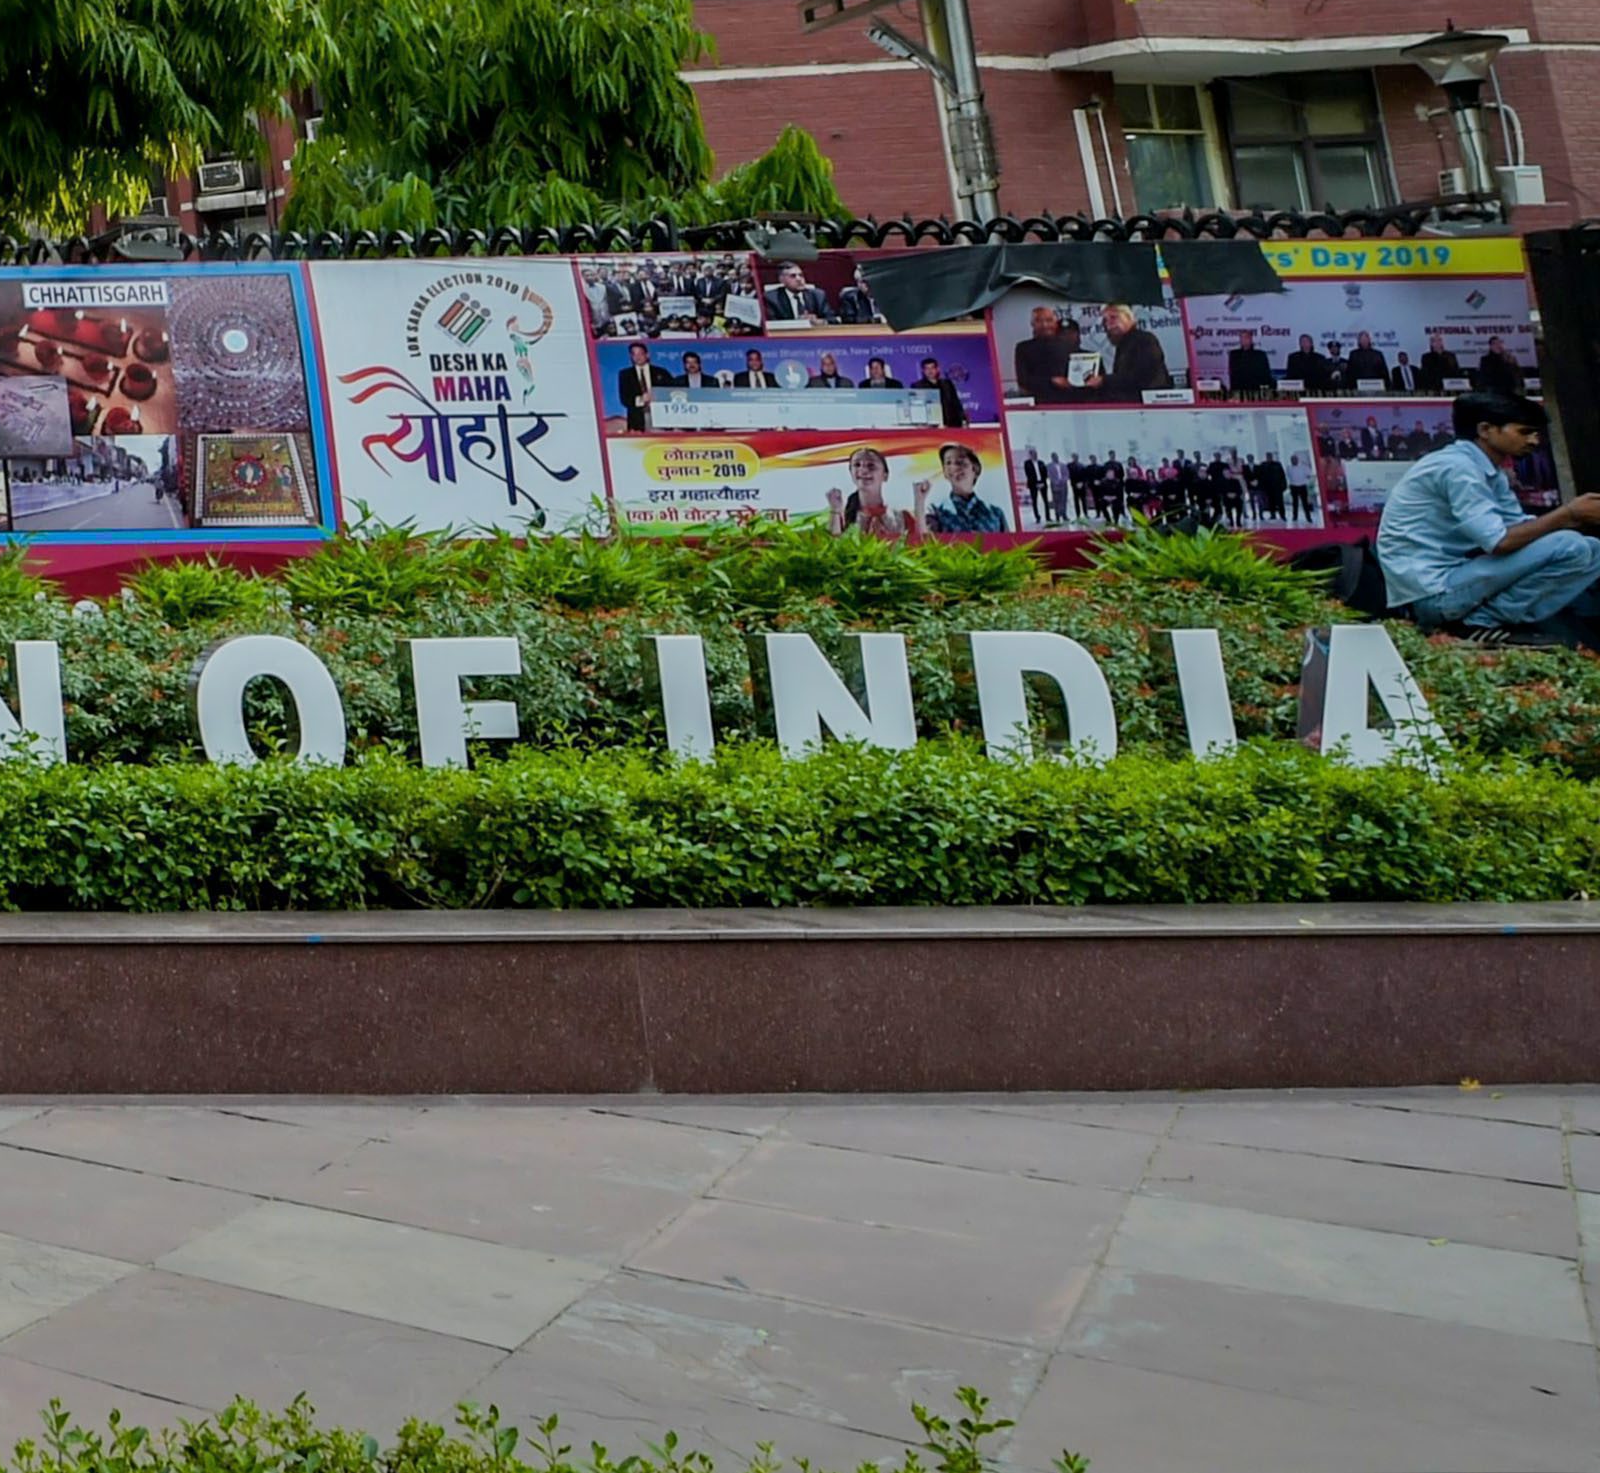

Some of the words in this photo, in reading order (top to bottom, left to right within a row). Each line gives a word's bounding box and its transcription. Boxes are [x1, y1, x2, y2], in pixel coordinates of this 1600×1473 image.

[1311, 247, 1368, 270] Day
[1378, 245, 1450, 267] 2019
[28, 284, 164, 304] CHHATTISGARH
[426, 273, 483, 298] ELECTION
[486, 274, 519, 295] 2019
[406, 295, 431, 332] SABHA
[406, 336, 422, 358] LOK
[429, 353, 478, 373] DESH
[483, 353, 508, 372] KA
[433, 375, 512, 401] MAHA
[664, 404, 699, 414] 1950
[663, 447, 735, 462] लोकसभा
[657, 465, 700, 480] चुनाव
[713, 463, 746, 477] 2019
[646, 488, 675, 503] इस
[626, 510, 653, 523] एक
[658, 507, 679, 523] भी
[193, 635, 523, 770] OF
[645, 623, 1455, 773] INDIA
